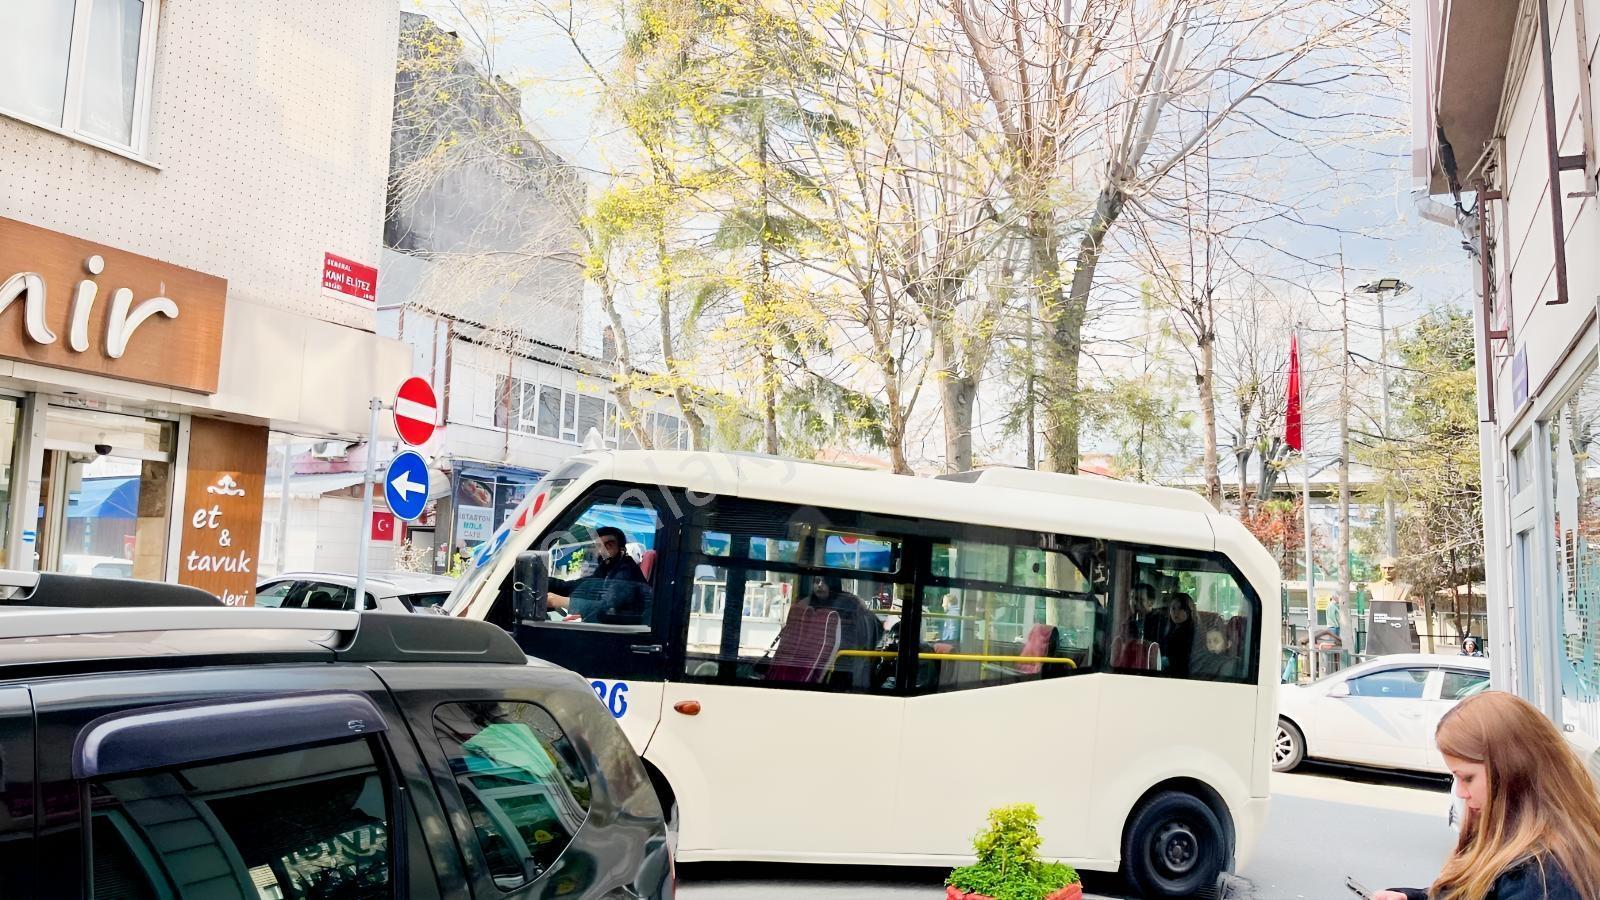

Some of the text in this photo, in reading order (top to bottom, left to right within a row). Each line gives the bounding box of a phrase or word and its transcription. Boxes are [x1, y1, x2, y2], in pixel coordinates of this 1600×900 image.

[192, 505, 222, 529] et
[219, 529, 231, 547] &
[187, 550, 251, 573] tavuk
[216, 589, 248, 606] leri
